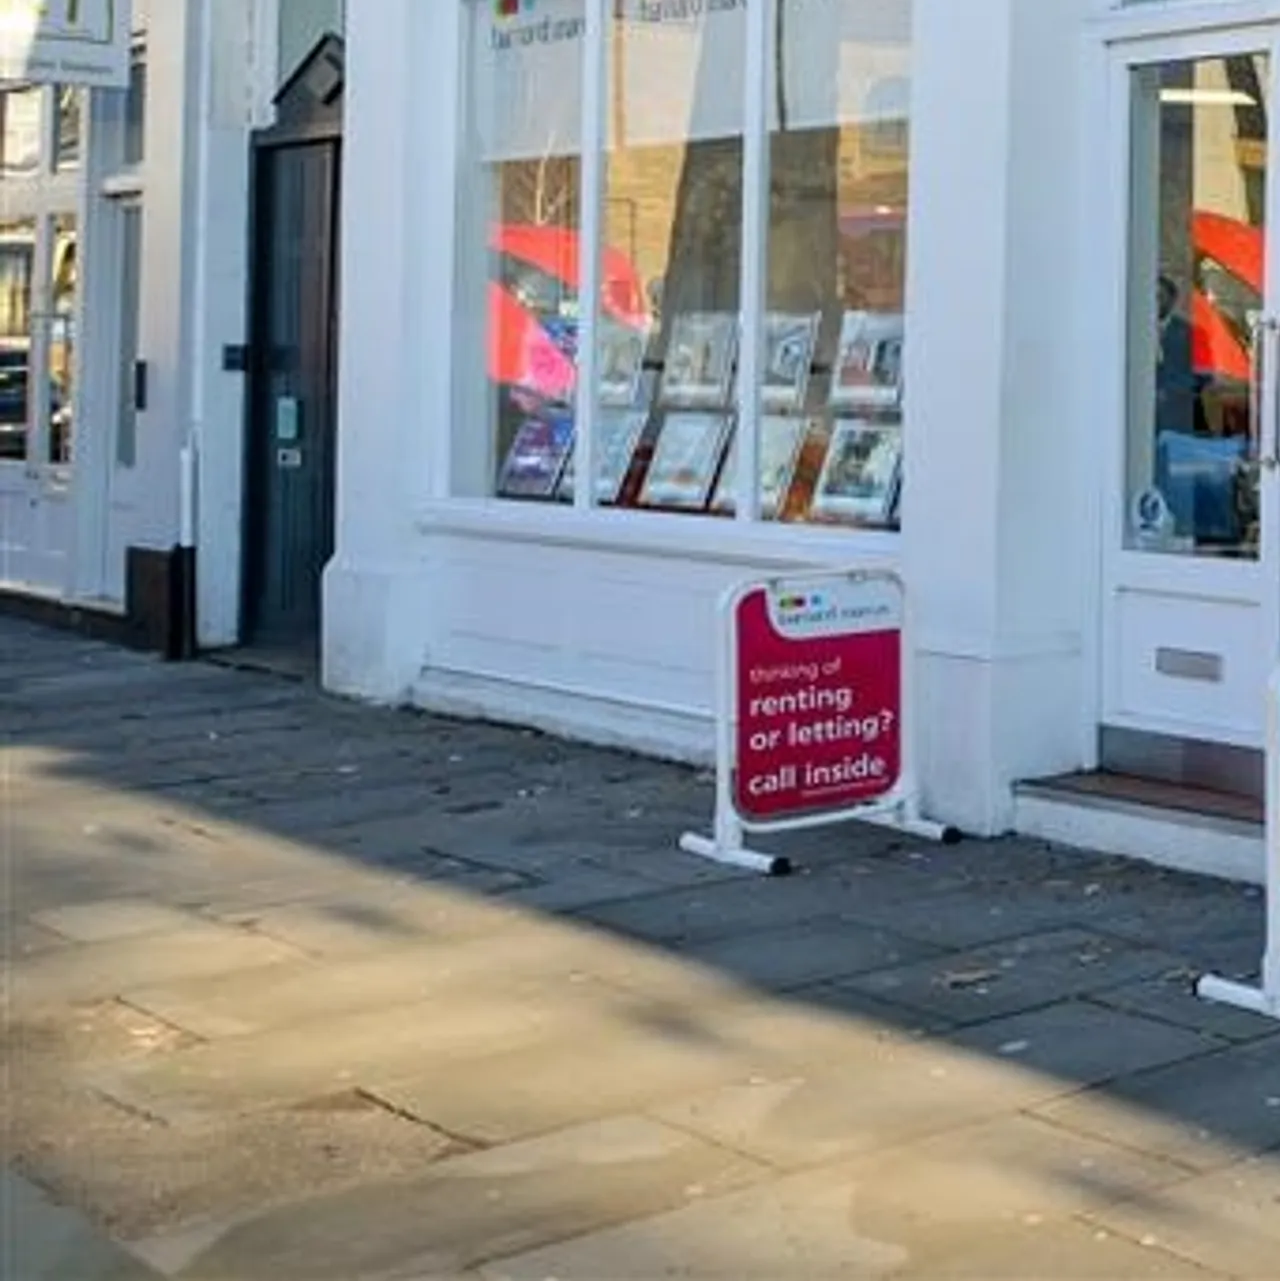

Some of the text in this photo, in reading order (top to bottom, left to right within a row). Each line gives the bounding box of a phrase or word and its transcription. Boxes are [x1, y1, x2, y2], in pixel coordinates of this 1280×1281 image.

[750, 657, 842, 684] thinking of
[750, 684, 852, 717] renting
[750, 708, 893, 751] or letting?
[749, 765, 797, 795] call
[804, 753, 886, 786] inside
